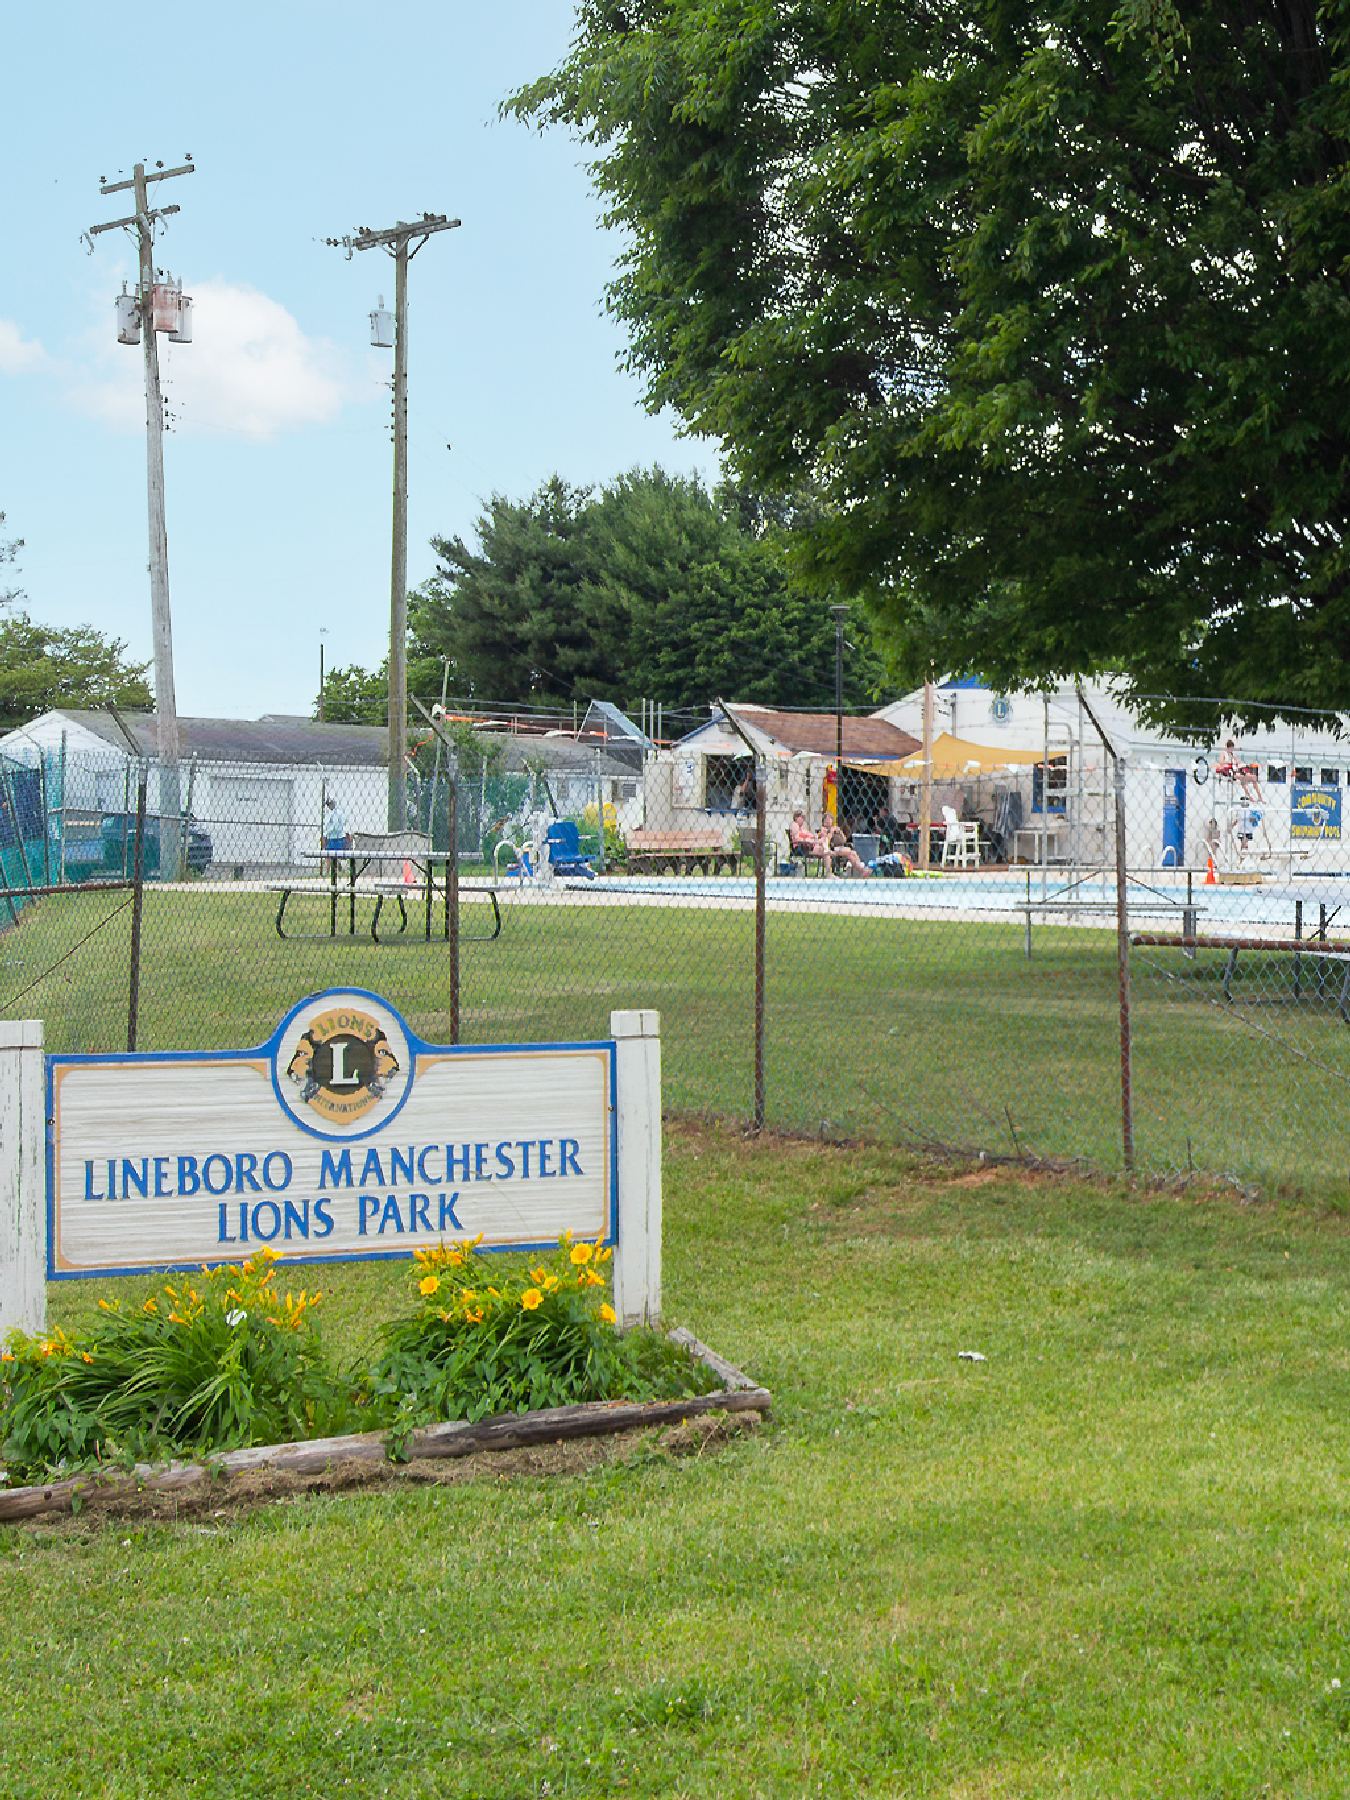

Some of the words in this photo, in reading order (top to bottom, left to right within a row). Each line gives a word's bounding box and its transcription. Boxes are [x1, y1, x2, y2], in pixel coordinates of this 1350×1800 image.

[1296, 792, 1336, 811] COMMUNITY
[316, 1014, 375, 1038] LIONS
[329, 1043, 359, 1084] L
[84, 1151, 293, 1200] LINEBORO
[317, 1138, 586, 1190] MANCHESTER
[217, 1197, 335, 1243] LIONS
[358, 1192, 465, 1236] PARK
